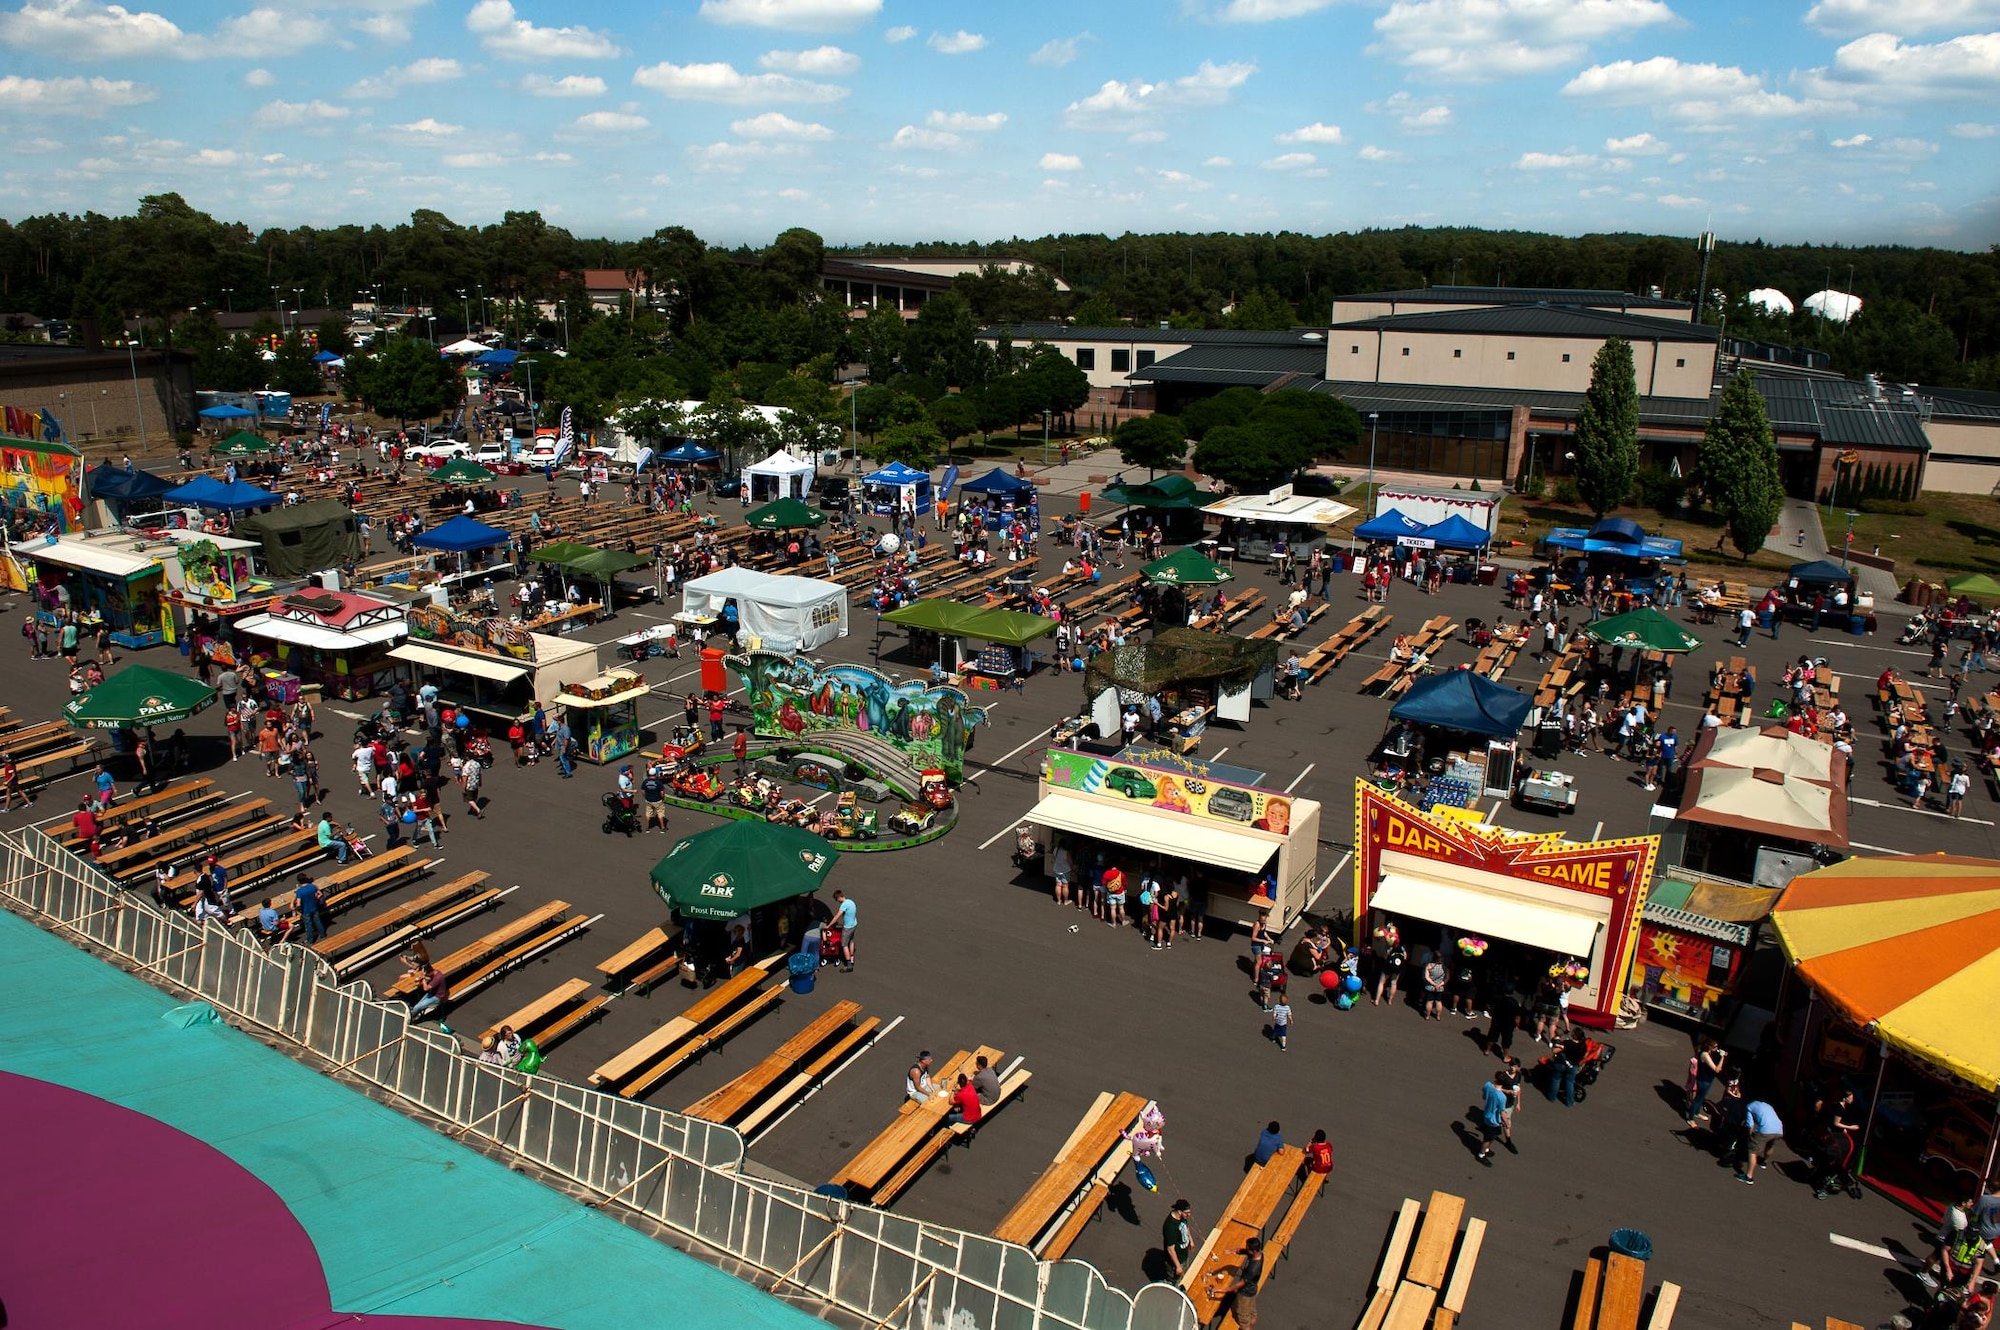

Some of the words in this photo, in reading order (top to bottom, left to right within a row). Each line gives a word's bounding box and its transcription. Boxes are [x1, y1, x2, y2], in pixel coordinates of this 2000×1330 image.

[1157, 571, 1178, 580] PARK
[139, 702, 176, 716] PARK
[167, 713, 186, 722] Natur
[97, 720, 120, 728] PARK
[1387, 816, 1457, 856] DART
[808, 852, 827, 873] PARK
[1533, 862, 1613, 890] GAME
[701, 884, 735, 897] PARK
[690, 906, 708, 915] Prost
[709, 907, 738, 918] Freunde
[1320, 1153, 1330, 1164] 10
